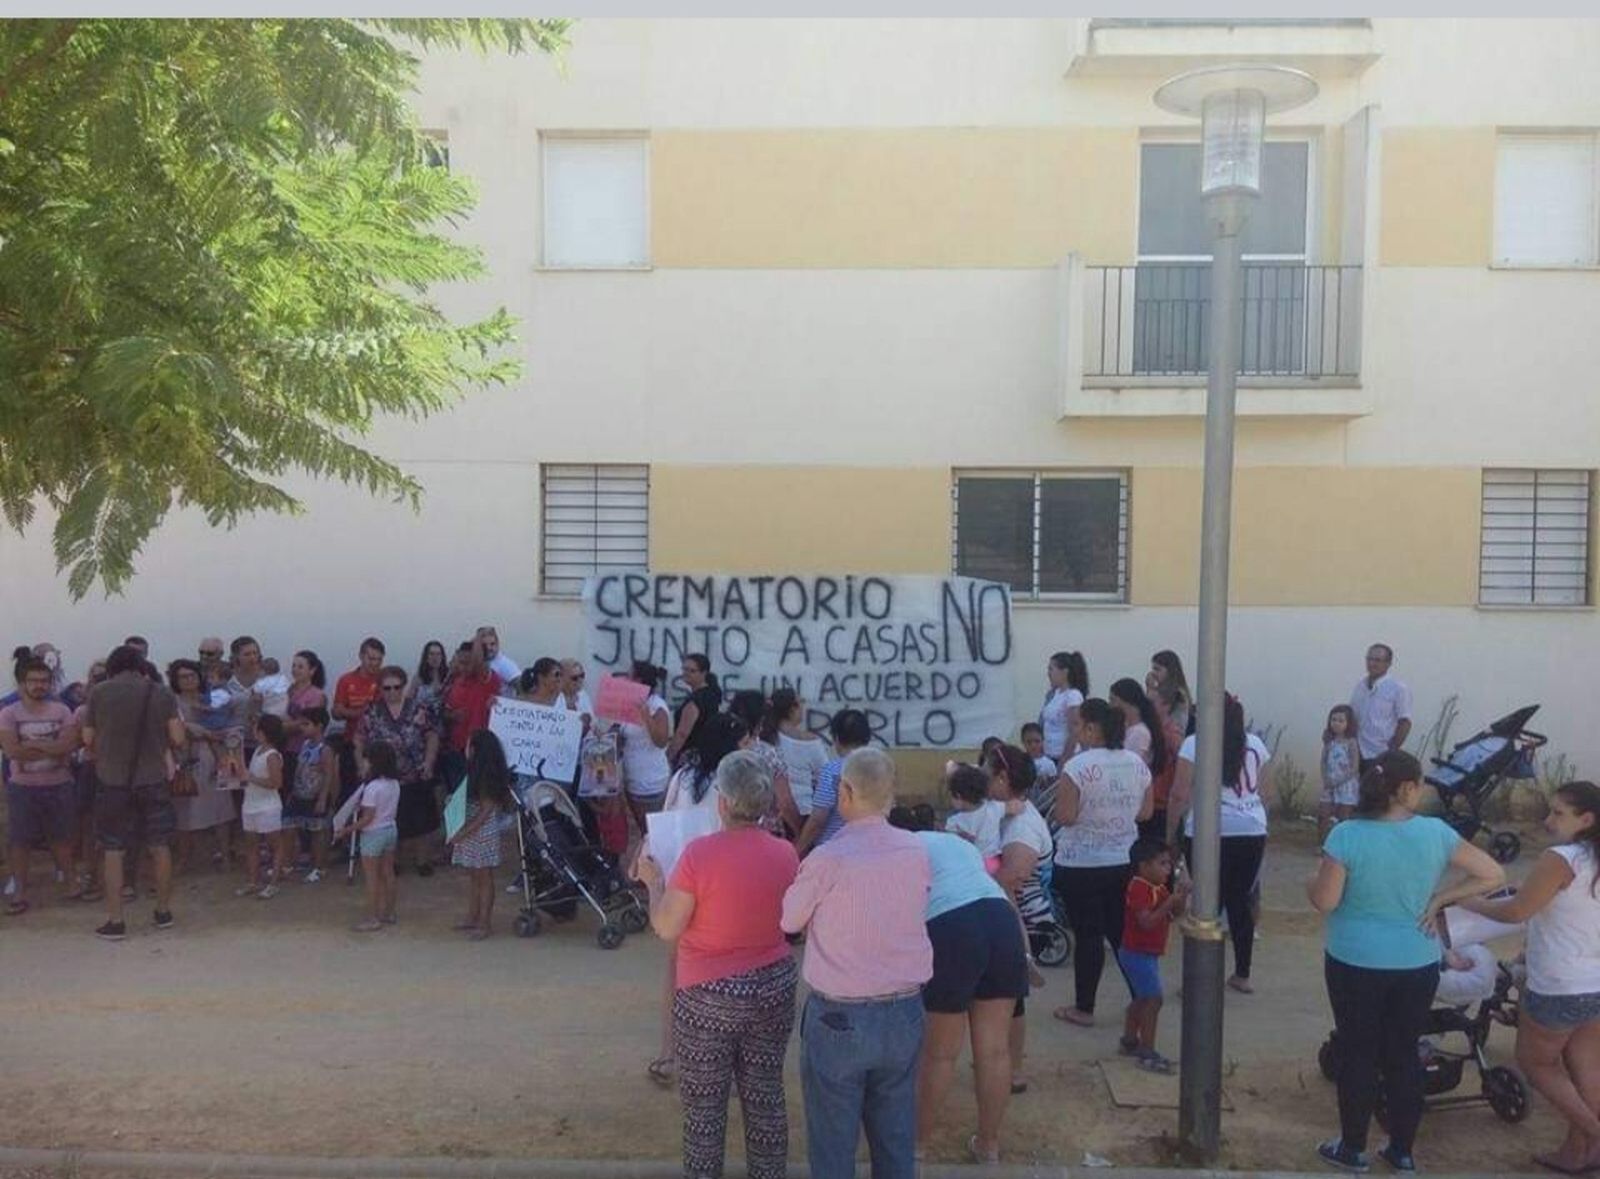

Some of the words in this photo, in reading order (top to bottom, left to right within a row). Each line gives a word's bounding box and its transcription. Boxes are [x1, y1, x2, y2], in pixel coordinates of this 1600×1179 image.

[593, 623, 751, 667] JUNTO
[779, 624, 810, 668] A
[824, 623, 938, 666] CASAS
[941, 580, 1012, 666] NO
[818, 671, 981, 702] ACUERDO
